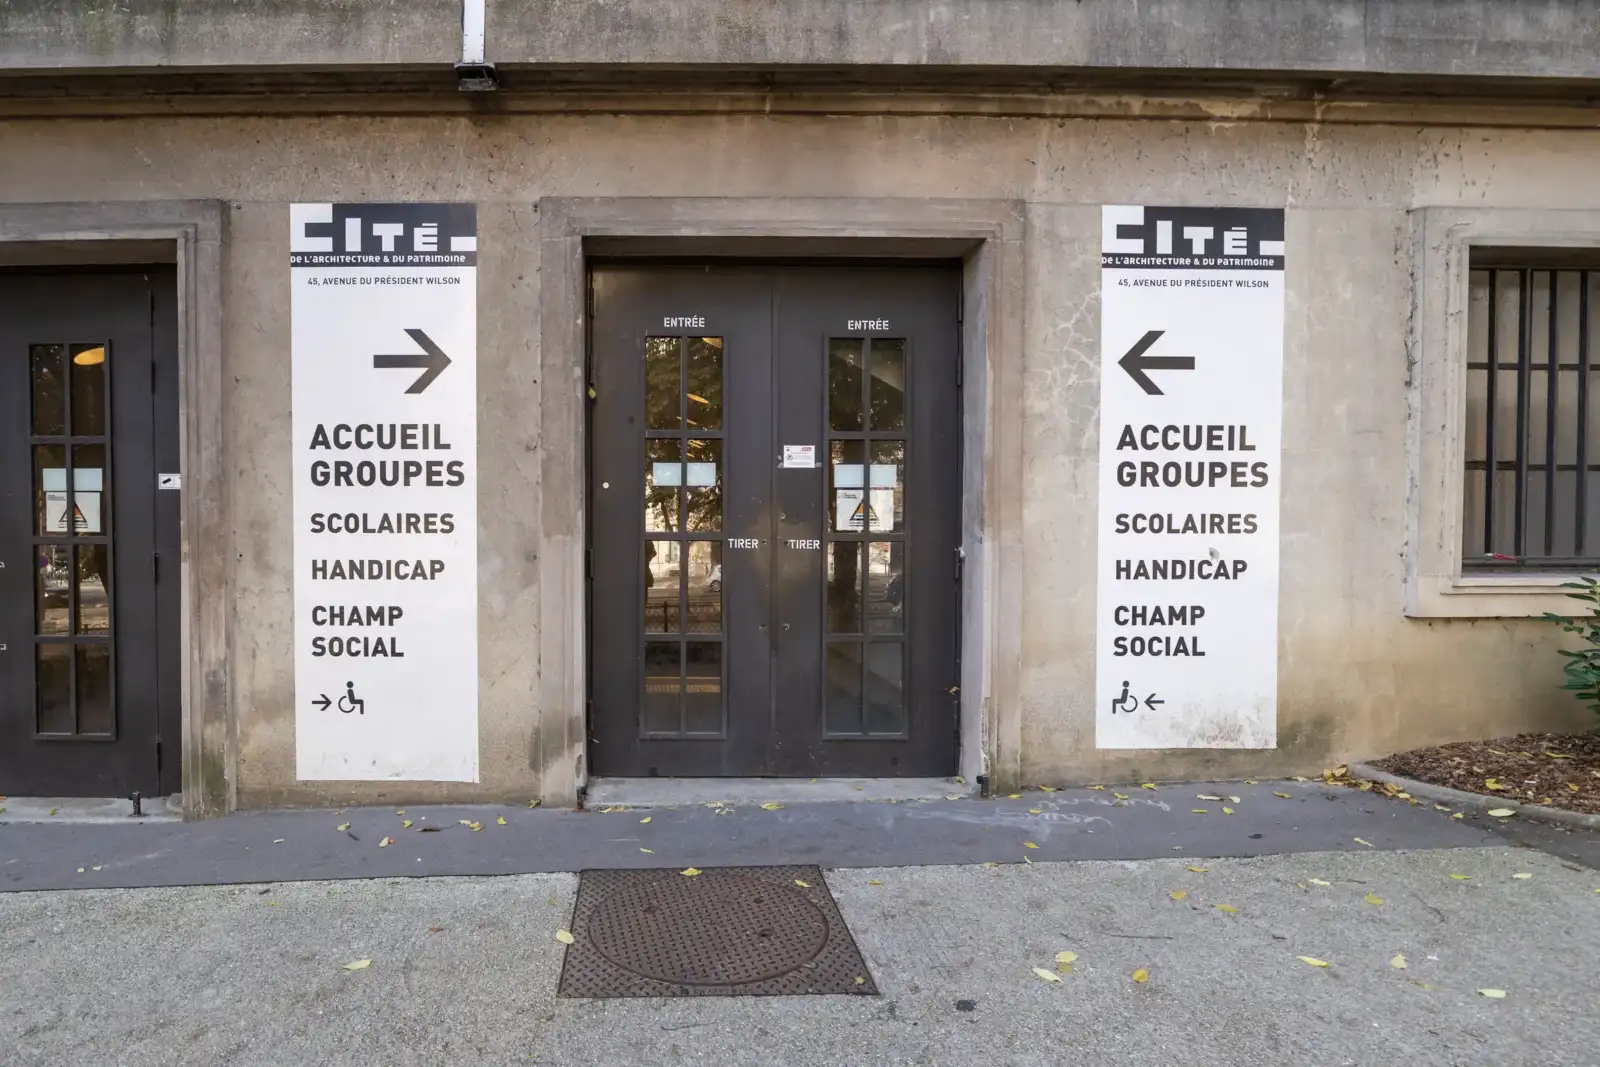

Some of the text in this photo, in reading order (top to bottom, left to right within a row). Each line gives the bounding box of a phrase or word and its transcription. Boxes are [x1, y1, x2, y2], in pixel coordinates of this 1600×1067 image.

[290, 203, 438, 252] CITÉ
[1102, 205, 1248, 256] CITÉ
[383, 255, 390, 263] &
[392, 255, 405, 263] DU
[1193, 257, 1200, 266] &
[1202, 257, 1215, 266] DU
[307, 275, 461, 287] 45, AVENUE DU PRÉSIDENT WILSON
[1118, 277, 1269, 288] 45, AVENUE DU PRÉSIDENT WILSON
[663, 315, 705, 328] ENTRÉE
[847, 318, 889, 331] ENTRÉE
[309, 423, 451, 450] ACCUEIL
[1116, 424, 1256, 451] ACCUEIL
[310, 460, 465, 487] GROUPES
[1116, 461, 1269, 487] GROUPES
[310, 512, 455, 534] SCOLAIRES
[1115, 513, 1258, 534] SCOLAIRES
[728, 538, 759, 549] TIRER
[789, 539, 820, 550] TIRER
[311, 559, 445, 580] HANDICAP
[1115, 559, 1248, 580] HANDICAP
[311, 605, 404, 626] CHAMP
[1114, 605, 1206, 626] CHAMP
[311, 636, 405, 657] SOCIAL
[1113, 636, 1206, 657] SOCIAL
